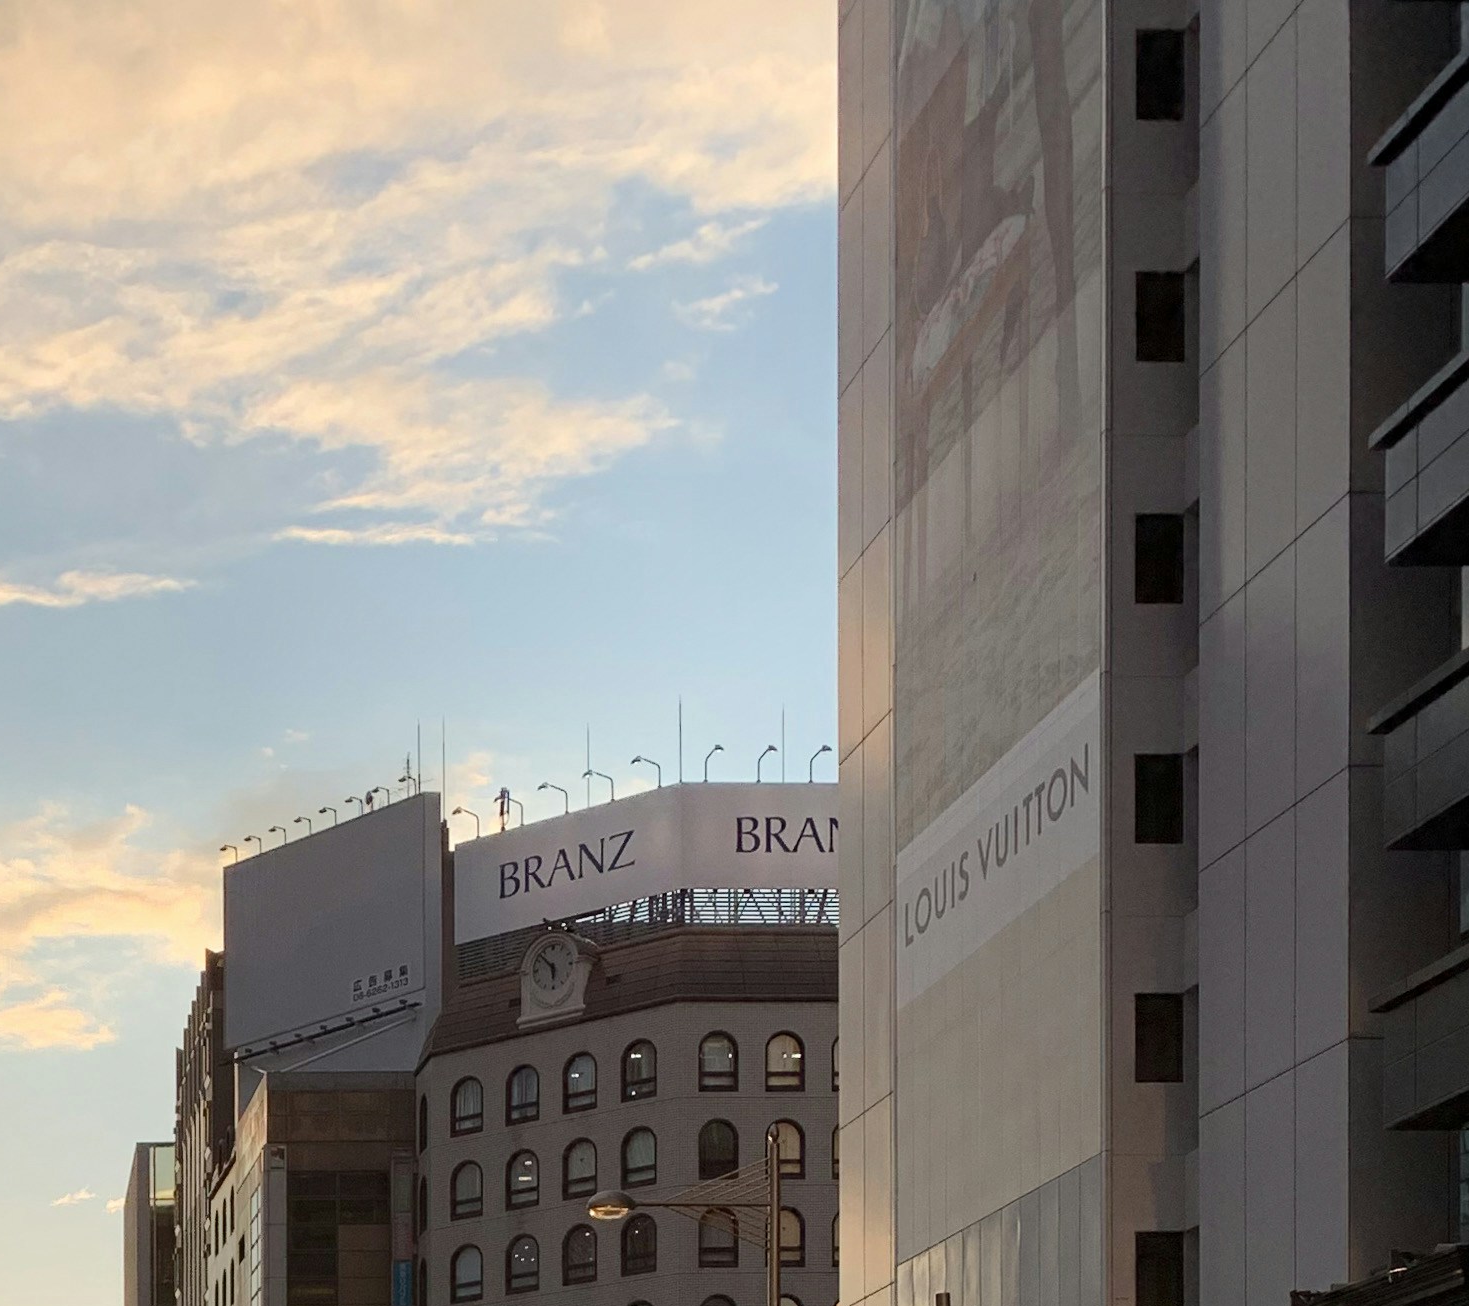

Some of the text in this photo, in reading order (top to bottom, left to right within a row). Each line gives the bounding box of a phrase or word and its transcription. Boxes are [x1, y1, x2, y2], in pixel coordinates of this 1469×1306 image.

[499, 830, 636, 899] BRANZ
[905, 742, 1089, 948] LOUIS VUITTON
